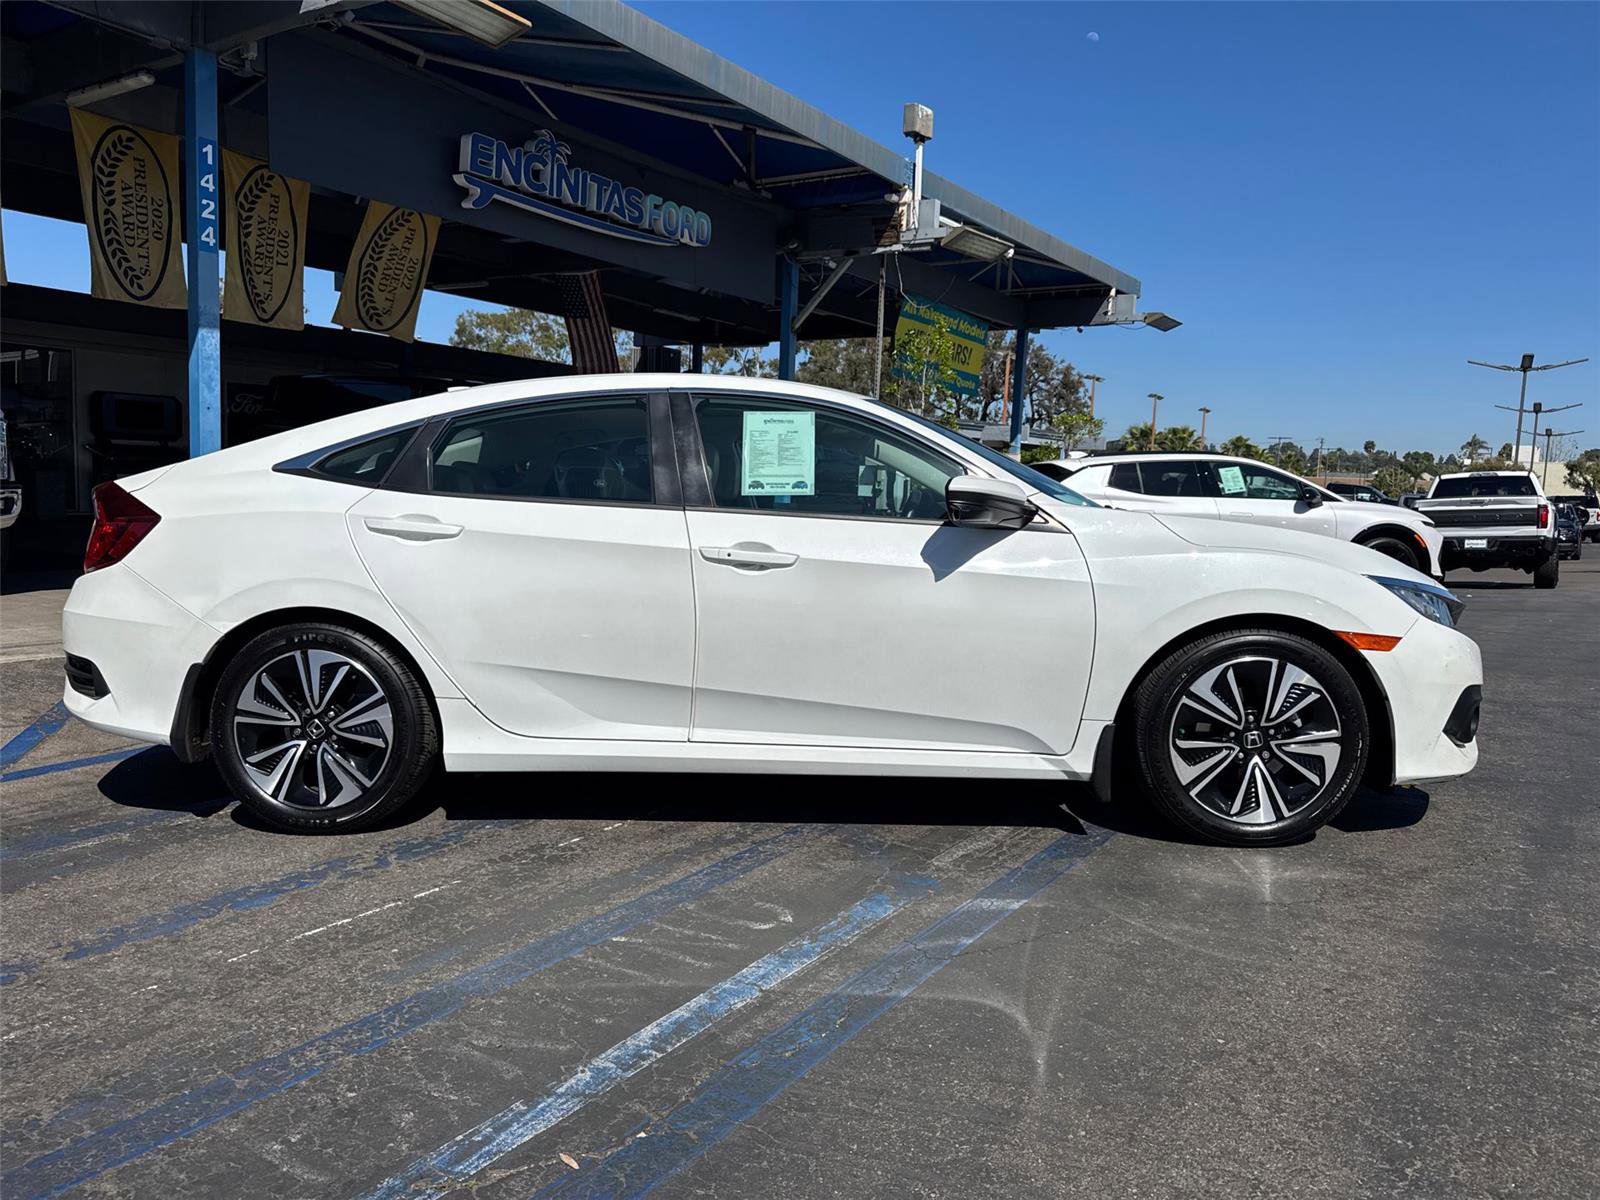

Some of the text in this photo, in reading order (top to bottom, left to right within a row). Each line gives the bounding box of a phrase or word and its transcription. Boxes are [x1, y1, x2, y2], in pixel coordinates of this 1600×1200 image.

[121, 179, 135, 248] AWARD
[133, 156, 151, 278] PRESIDENT'S
[151, 197, 164, 241] 2020
[647, 194, 712, 247] FORD
[254, 215, 267, 275] AWARD
[263, 193, 280, 302] PRESIDENT'S
[276, 230, 289, 267] 2021
[378, 243, 399, 293] AWARD
[382, 226, 417, 316] PRESIDENT'S
[400, 257, 419, 290] 2022
[959, 319, 985, 340] Models
